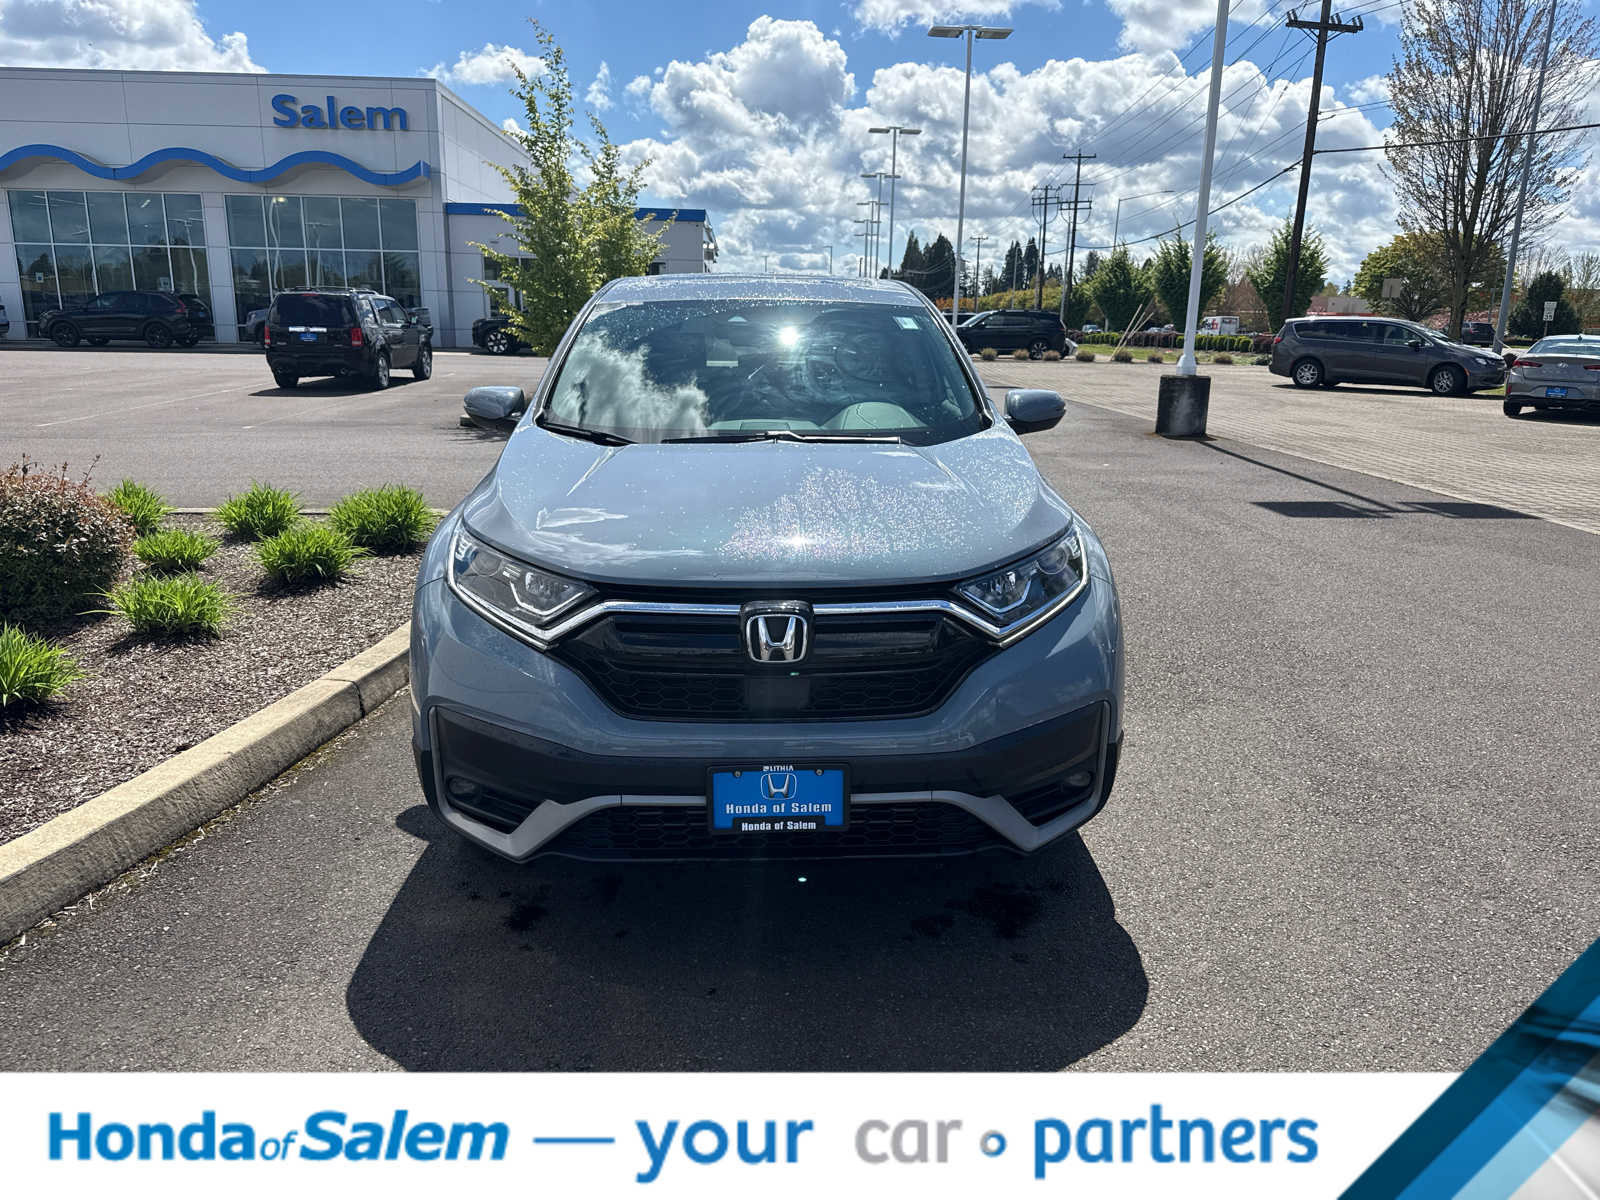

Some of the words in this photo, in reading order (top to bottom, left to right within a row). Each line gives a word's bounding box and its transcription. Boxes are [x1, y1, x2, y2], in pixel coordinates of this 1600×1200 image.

[271, 93, 409, 131] Salem
[725, 803, 767, 814] Honda
[773, 802, 785, 813] of
[791, 802, 832, 813] Salem
[741, 822, 771, 832] Honda
[774, 821, 784, 831] of
[787, 821, 817, 830] Salem
